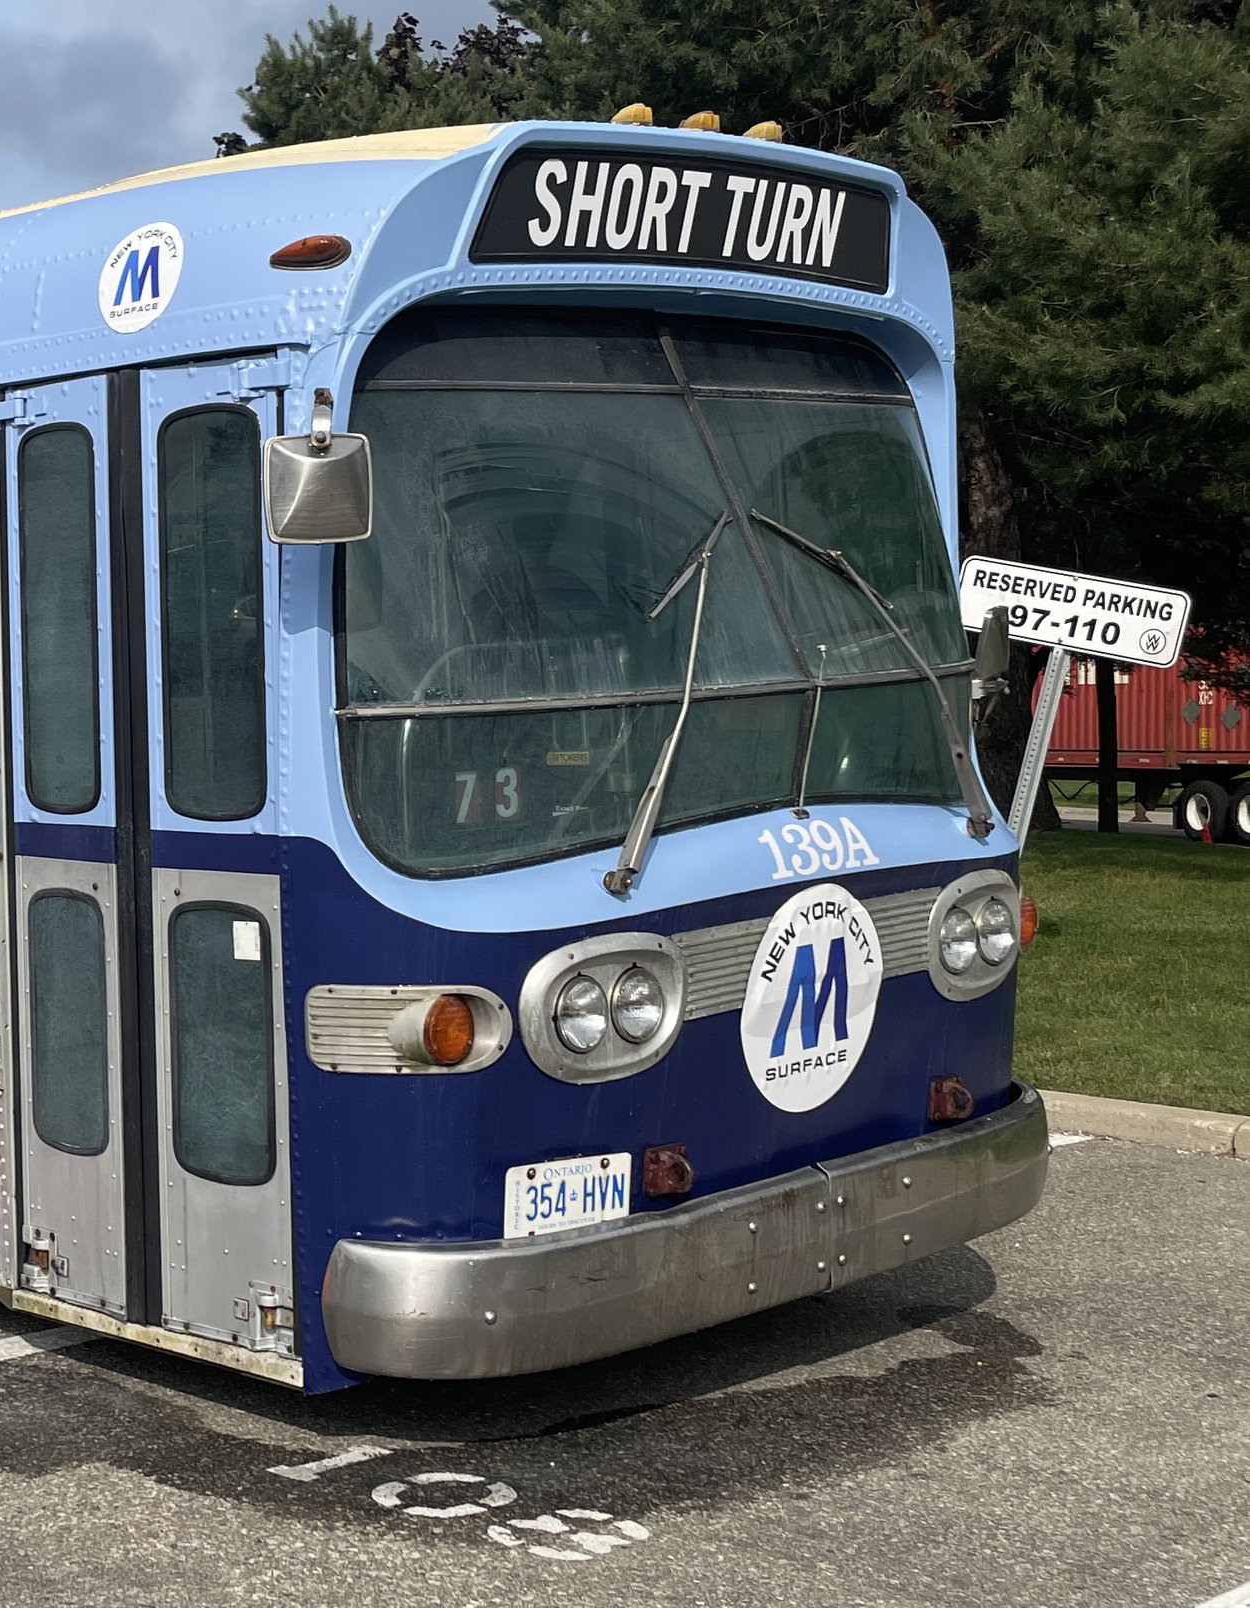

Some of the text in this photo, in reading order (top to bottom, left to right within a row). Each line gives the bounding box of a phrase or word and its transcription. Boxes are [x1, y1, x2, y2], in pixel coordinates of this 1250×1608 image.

[527, 158, 847, 268] SHORT TURN
[110, 229, 178, 268] NEW YORK CITY
[113, 245, 160, 307] M
[110, 302, 159, 319] SURFACE
[972, 569, 1173, 622] RESERVED PARKING
[1007, 604, 1121, 646] 97-110
[757, 816, 880, 881] 139A
[760, 900, 875, 983] NEW YORK CITY
[769, 936, 849, 1059] M
[765, 1048, 848, 1082] SURFACE
[525, 1172, 626, 1222] 354 HVN
[543, 1163, 593, 1181] ONTARIO
